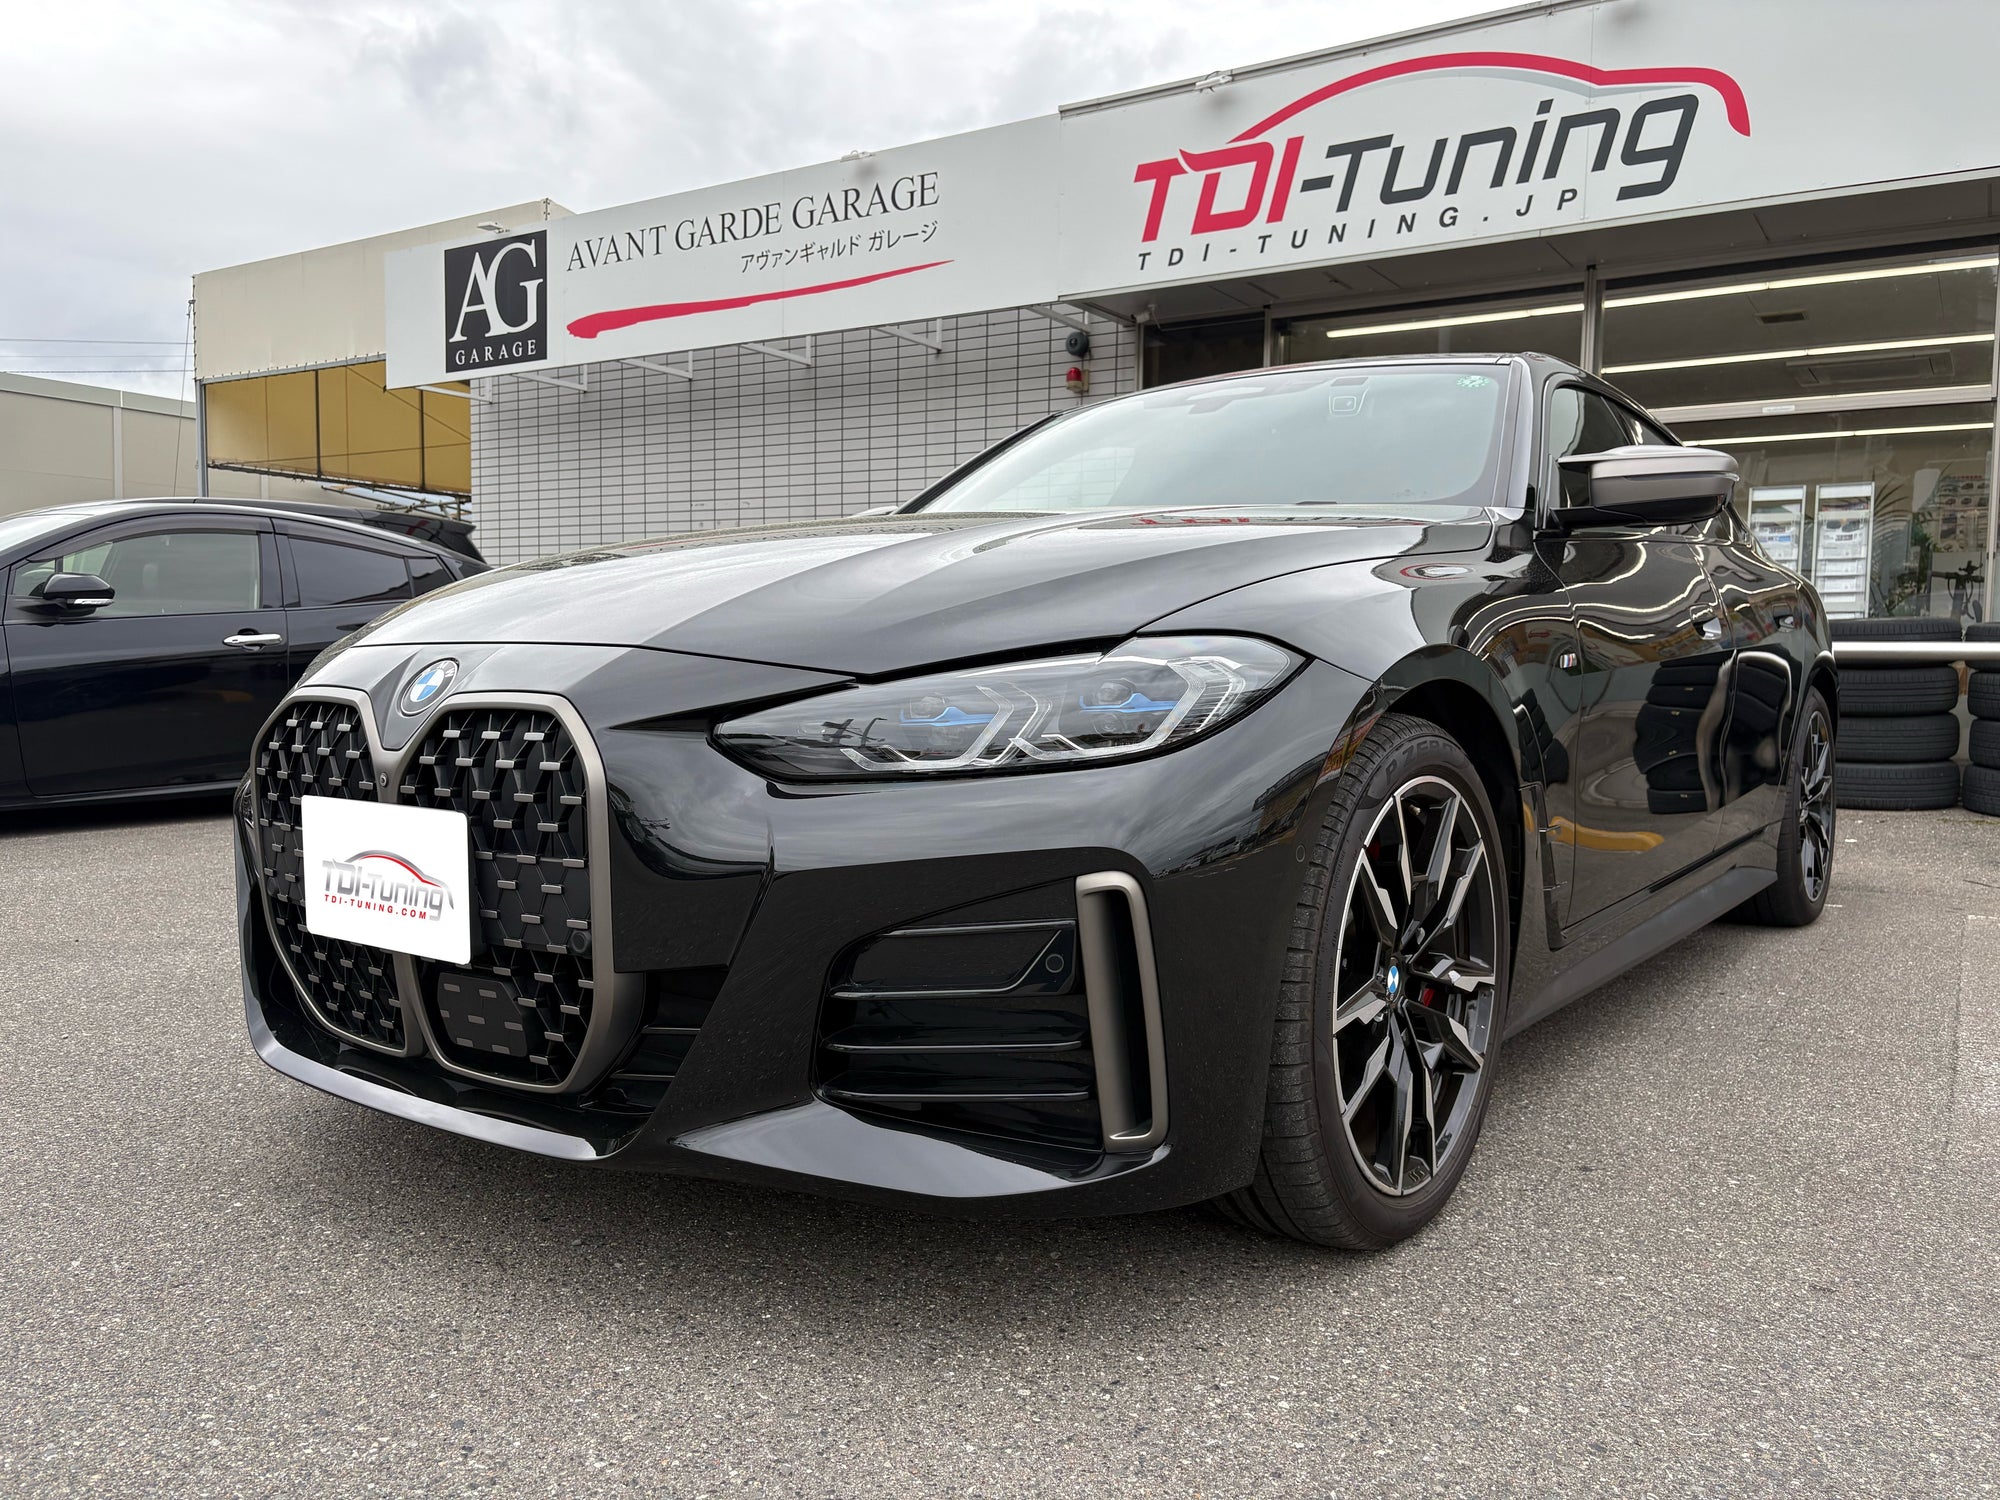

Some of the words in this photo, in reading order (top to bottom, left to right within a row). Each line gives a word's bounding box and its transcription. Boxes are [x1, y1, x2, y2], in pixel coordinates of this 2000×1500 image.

[566, 225, 667, 272] AVANT
[674, 202, 782, 251] GARDE
[792, 172, 940, 229] GARAGE
[741, 235, 861, 273] アヴァンギャルド
[868, 220, 938, 252] ガレージ
[449, 239, 543, 342] AG
[455, 339, 537, 366] GARAGE
[324, 894, 427, 919] TDI-TUNING.COM
